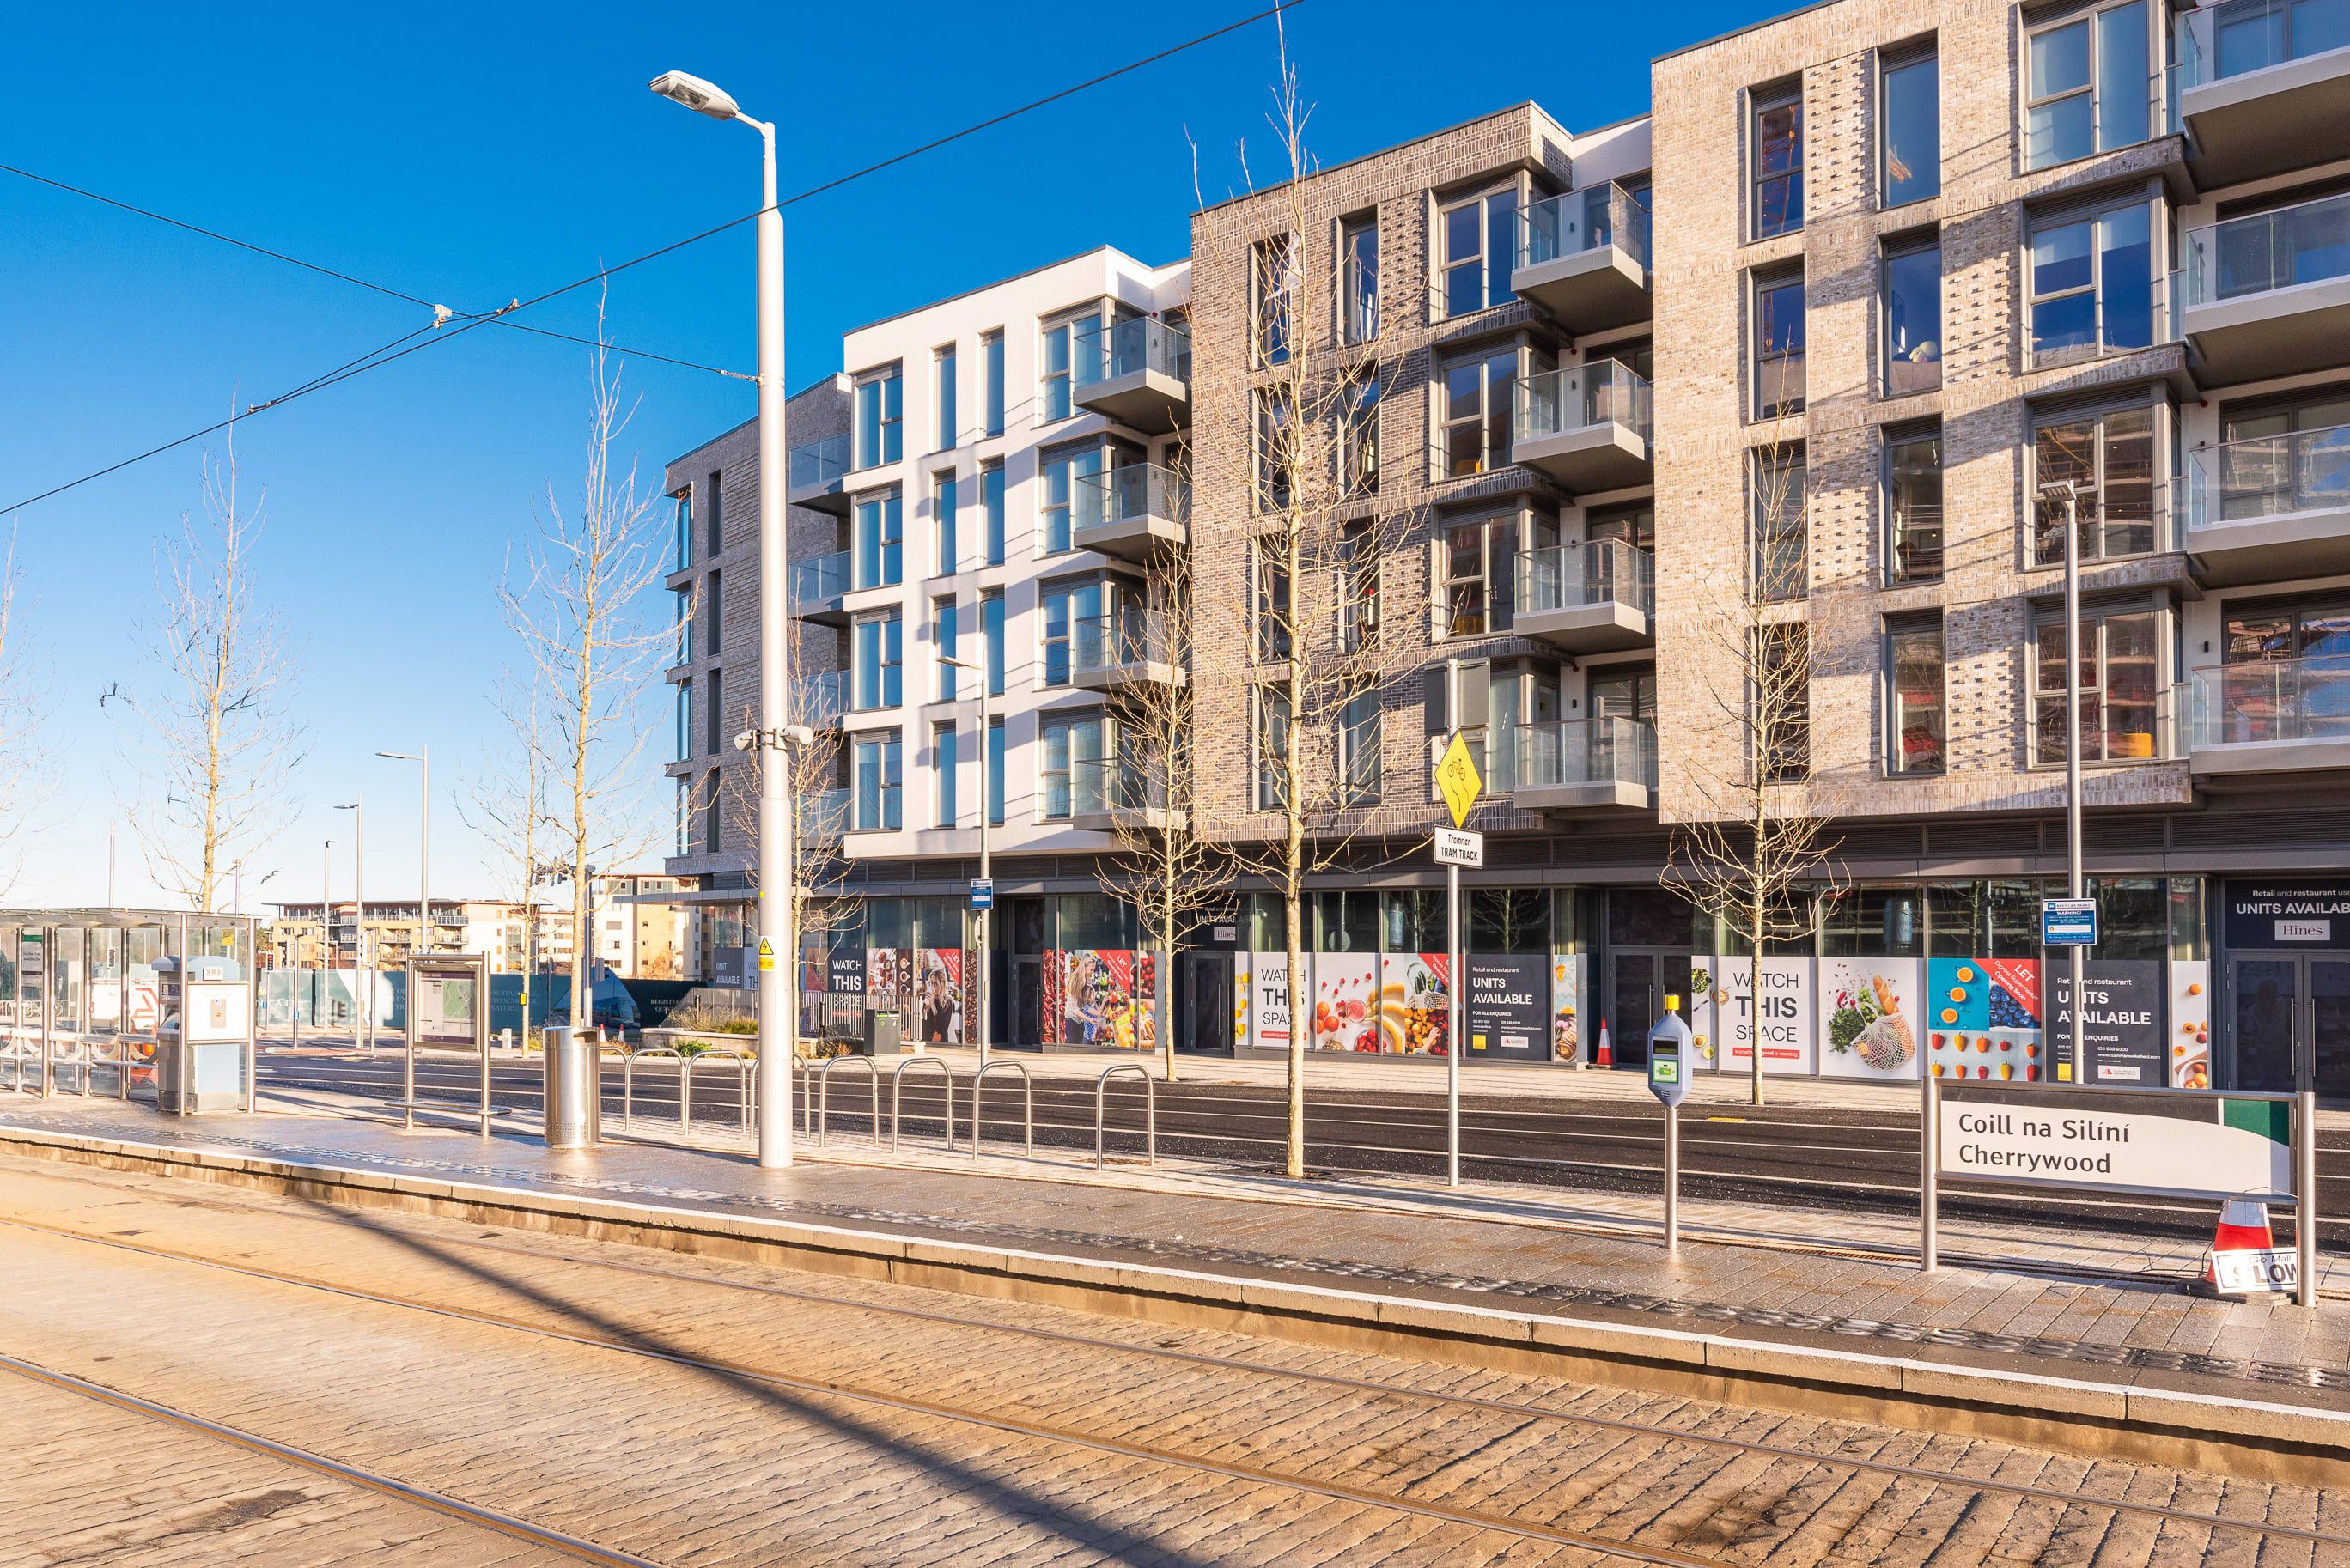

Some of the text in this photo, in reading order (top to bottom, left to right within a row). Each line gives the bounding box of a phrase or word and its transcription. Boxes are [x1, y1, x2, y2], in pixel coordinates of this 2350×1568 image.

[1441, 847, 1478, 861] TRAM TRACK
[2236, 903, 2282, 915] UNITS
[2282, 925, 2323, 936] Hines
[715, 963, 728, 971] UNIT
[832, 959, 862, 971] WATCH
[1117, 955, 1128, 968] LET
[715, 975, 740, 984] AVAILABLE
[1733, 972, 1799, 988] WTCH
[2014, 964, 2035, 982] LET
[748, 975, 759, 989] TH
[832, 975, 861, 991] THIS
[1472, 977, 1506, 988] UNITS
[1994, 960, 2038, 1001] Express Supermarket
[1994, 970, 2026, 1000] Opening Soon
[1472, 994, 1533, 1005] AVAILABLE
[2057, 990, 2110, 1004] UITS
[2057, 1010, 2151, 1025] AAILABLE
[1959, 1114, 2130, 1142] Coill na Silíní
[1959, 1145, 2110, 1174] Cherrywood
